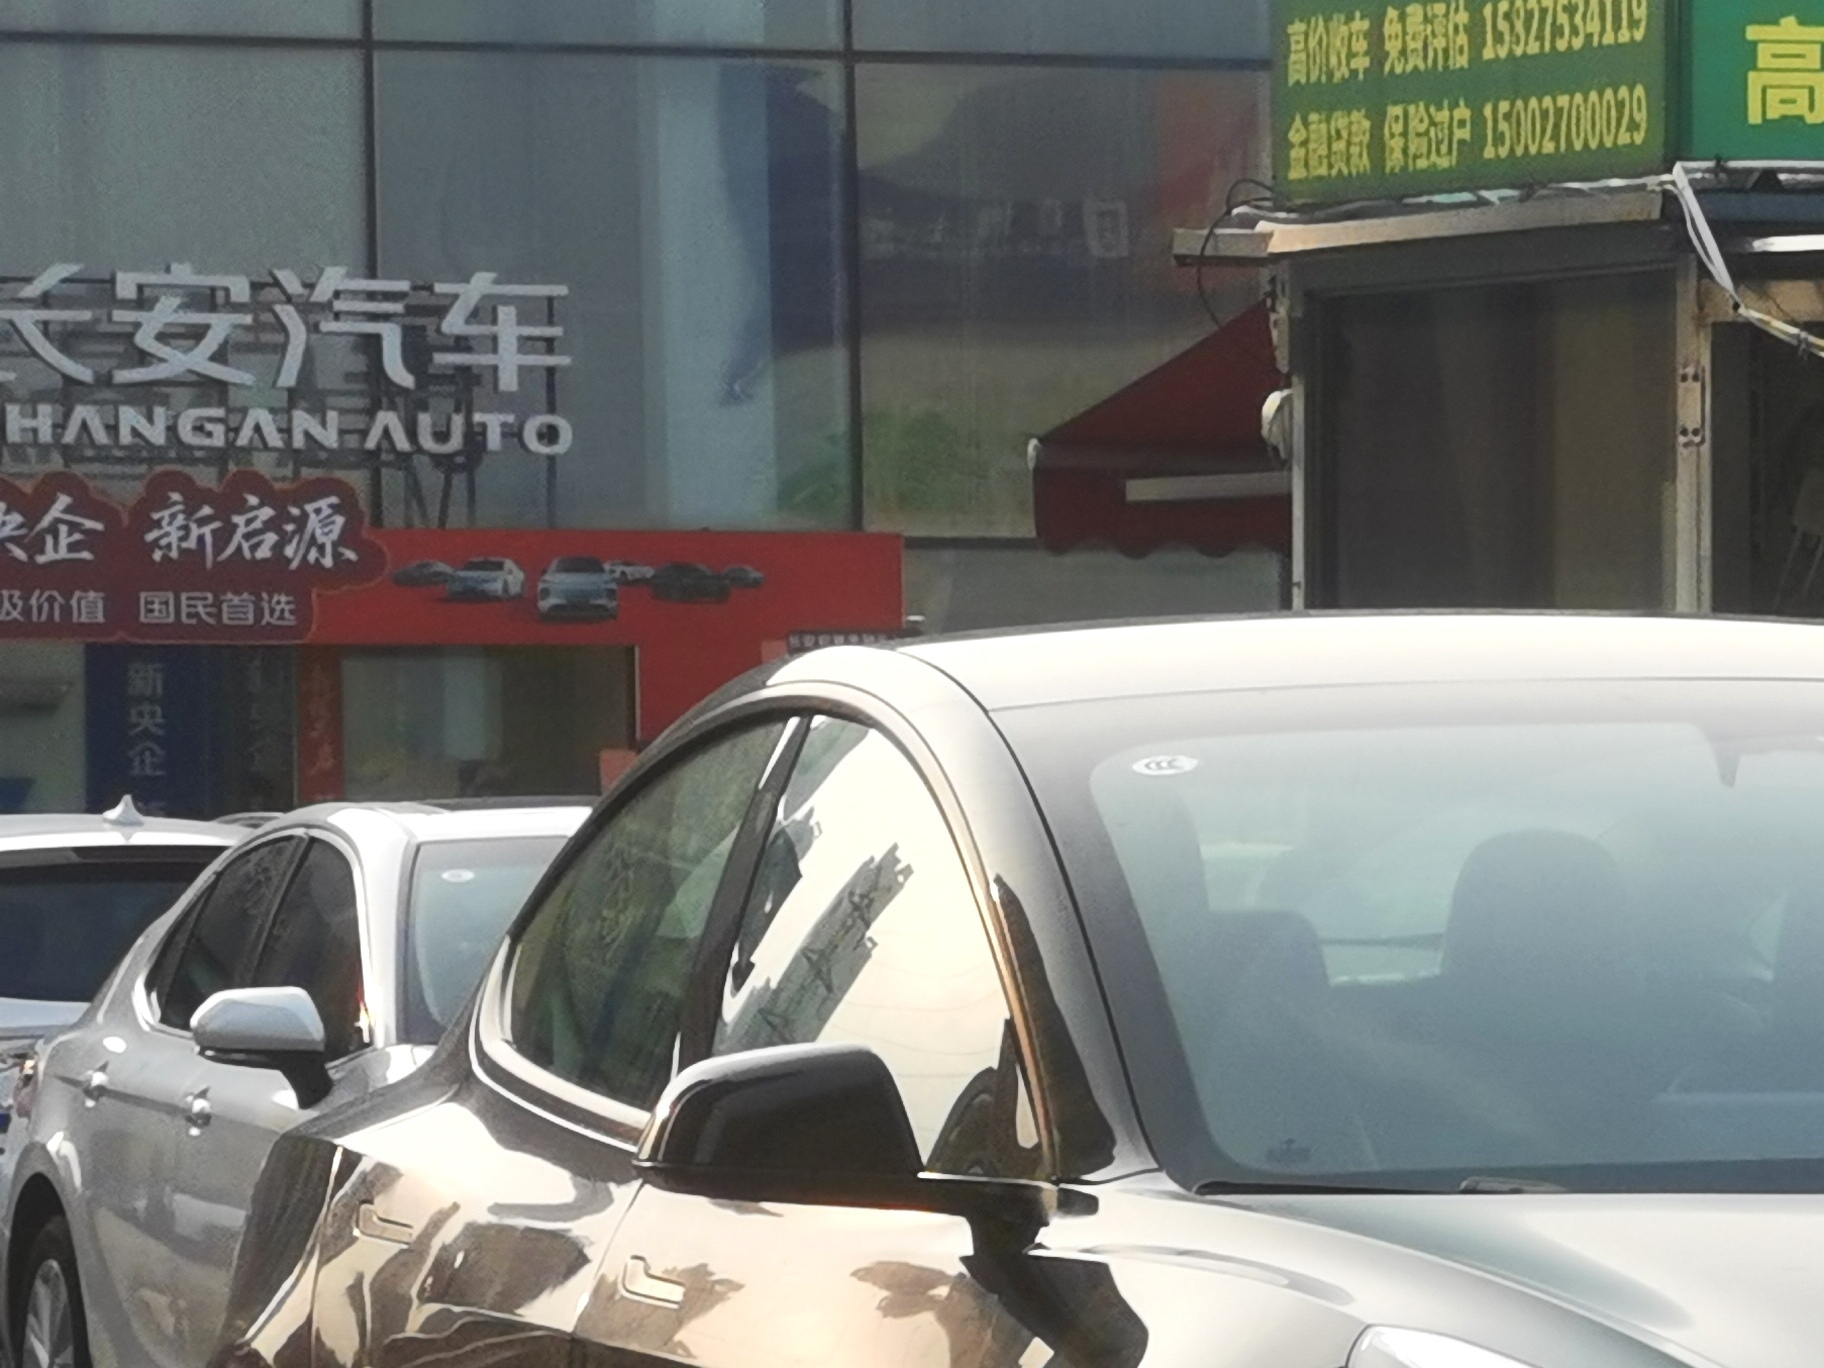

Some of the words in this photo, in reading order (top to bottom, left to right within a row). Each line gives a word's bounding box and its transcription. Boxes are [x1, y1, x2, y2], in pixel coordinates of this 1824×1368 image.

[1287, 10, 1370, 87] 高价收车
[1384, 0, 1469, 76] 免费评估
[1483, 0, 1647, 61] 15827534119
[1288, 108, 1371, 180] 金融贷款
[1384, 96, 1471, 174] 保险过户
[1483, 83, 1647, 159] 15002700029
[364, 410, 573, 456] AUTO
[144, 491, 359, 570] 新启源
[139, 590, 297, 626] 国民首选
